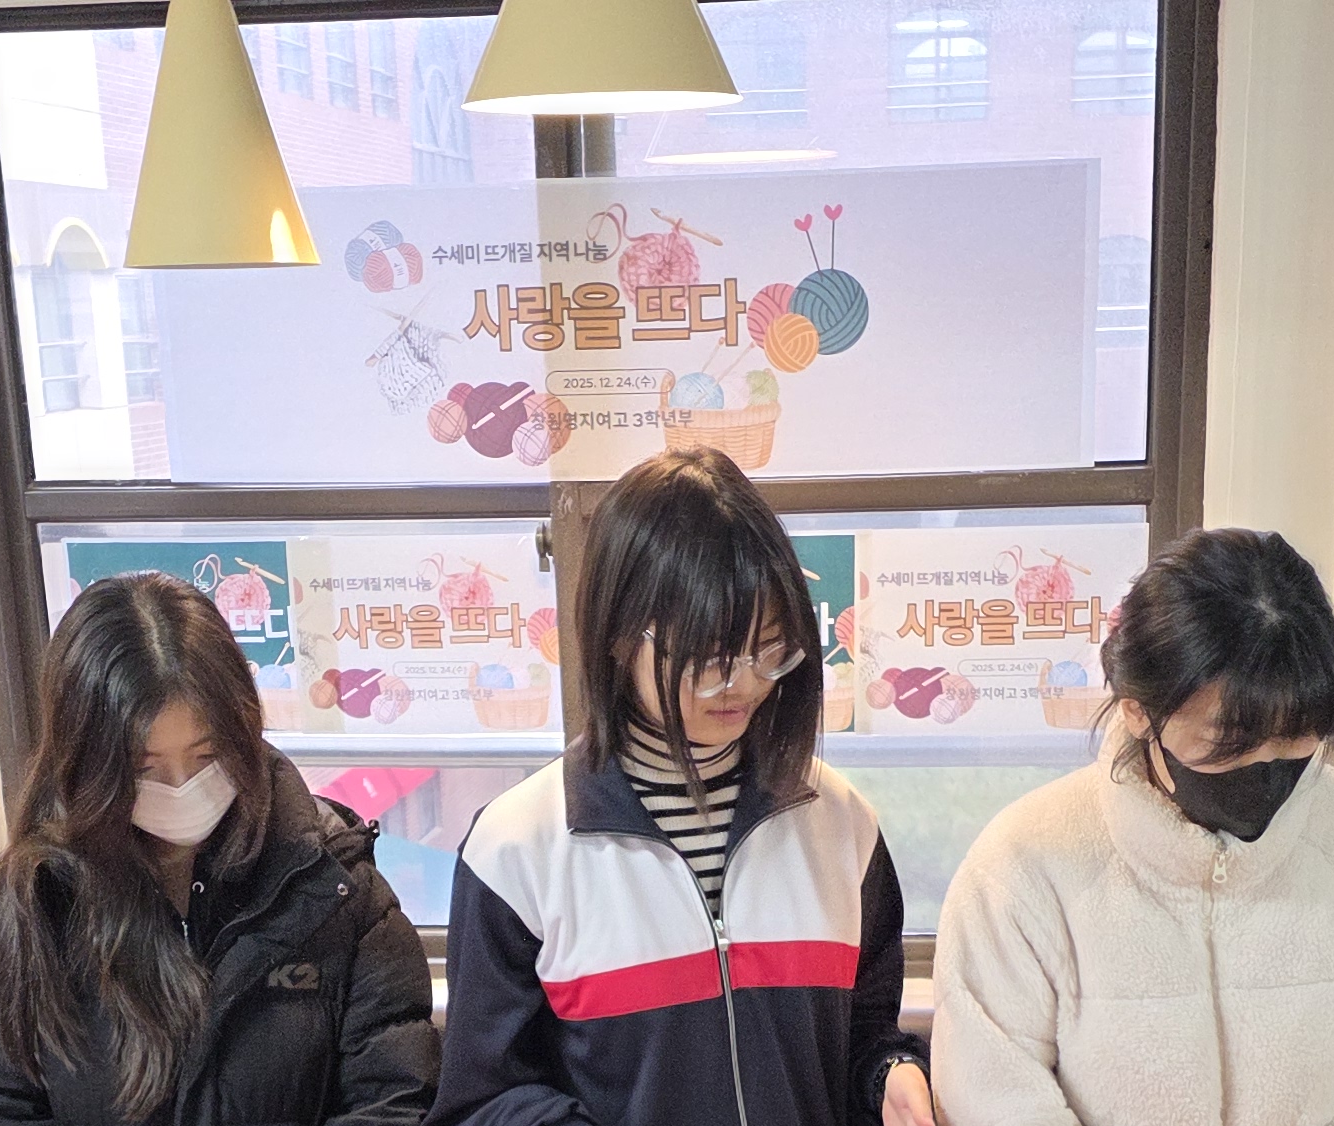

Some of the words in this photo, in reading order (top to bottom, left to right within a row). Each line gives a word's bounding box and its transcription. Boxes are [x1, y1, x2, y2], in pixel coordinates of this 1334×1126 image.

[432, 243, 481, 266] 수세미
[484, 242, 534, 263] 뜨개질
[537, 241, 571, 260] 지역
[574, 240, 608, 262] 나눔
[464, 283, 625, 352] 사랑을
[632, 278, 747, 347] 뜨다
[530, 411, 628, 432] 창원명지여고
[632, 409, 694, 429] 3학년부
[309, 578, 344, 593] 수세미
[347, 577, 382, 592] 뜨개질
[384, 576, 407, 591] 지역
[408, 576, 432, 591] 나눔
[876, 572, 914, 588] 수세미
[916, 571, 953, 586] 뜨개질
[956, 570, 981, 585] 지역
[983, 570, 1010, 586] 나눔
[333, 602, 445, 650] 사랑을
[449, 602, 526, 648] 뜨다
[896, 598, 1019, 647] 사랑을
[1022, 596, 1107, 644] 뜨다
[269, 963, 320, 990] K2
